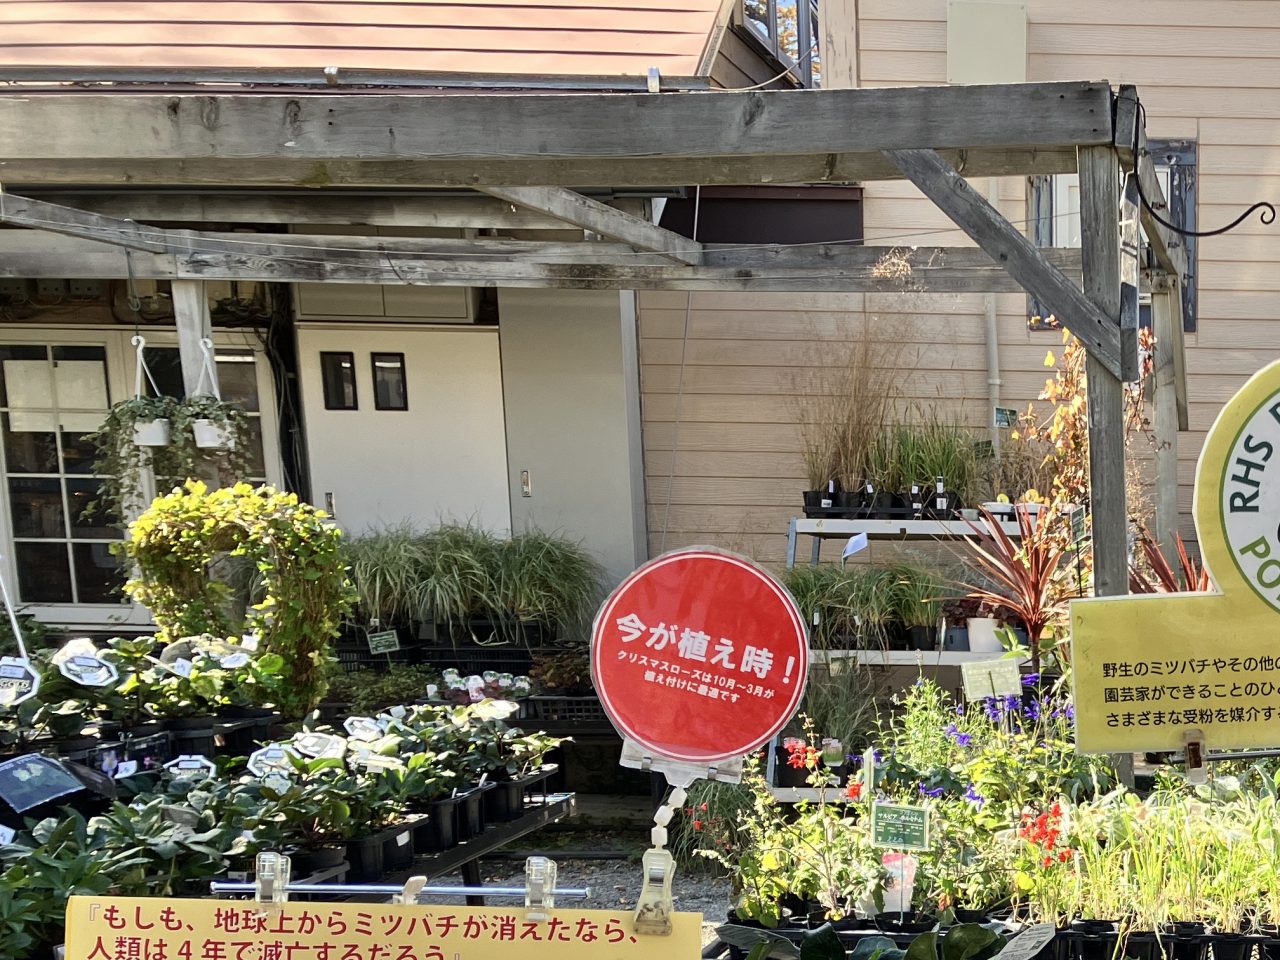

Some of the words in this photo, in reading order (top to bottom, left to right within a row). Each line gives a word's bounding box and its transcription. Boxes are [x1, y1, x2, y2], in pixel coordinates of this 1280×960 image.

[1229, 434, 1274, 513] RHS
[644, 670, 740, 703] 植え付けに最適です
